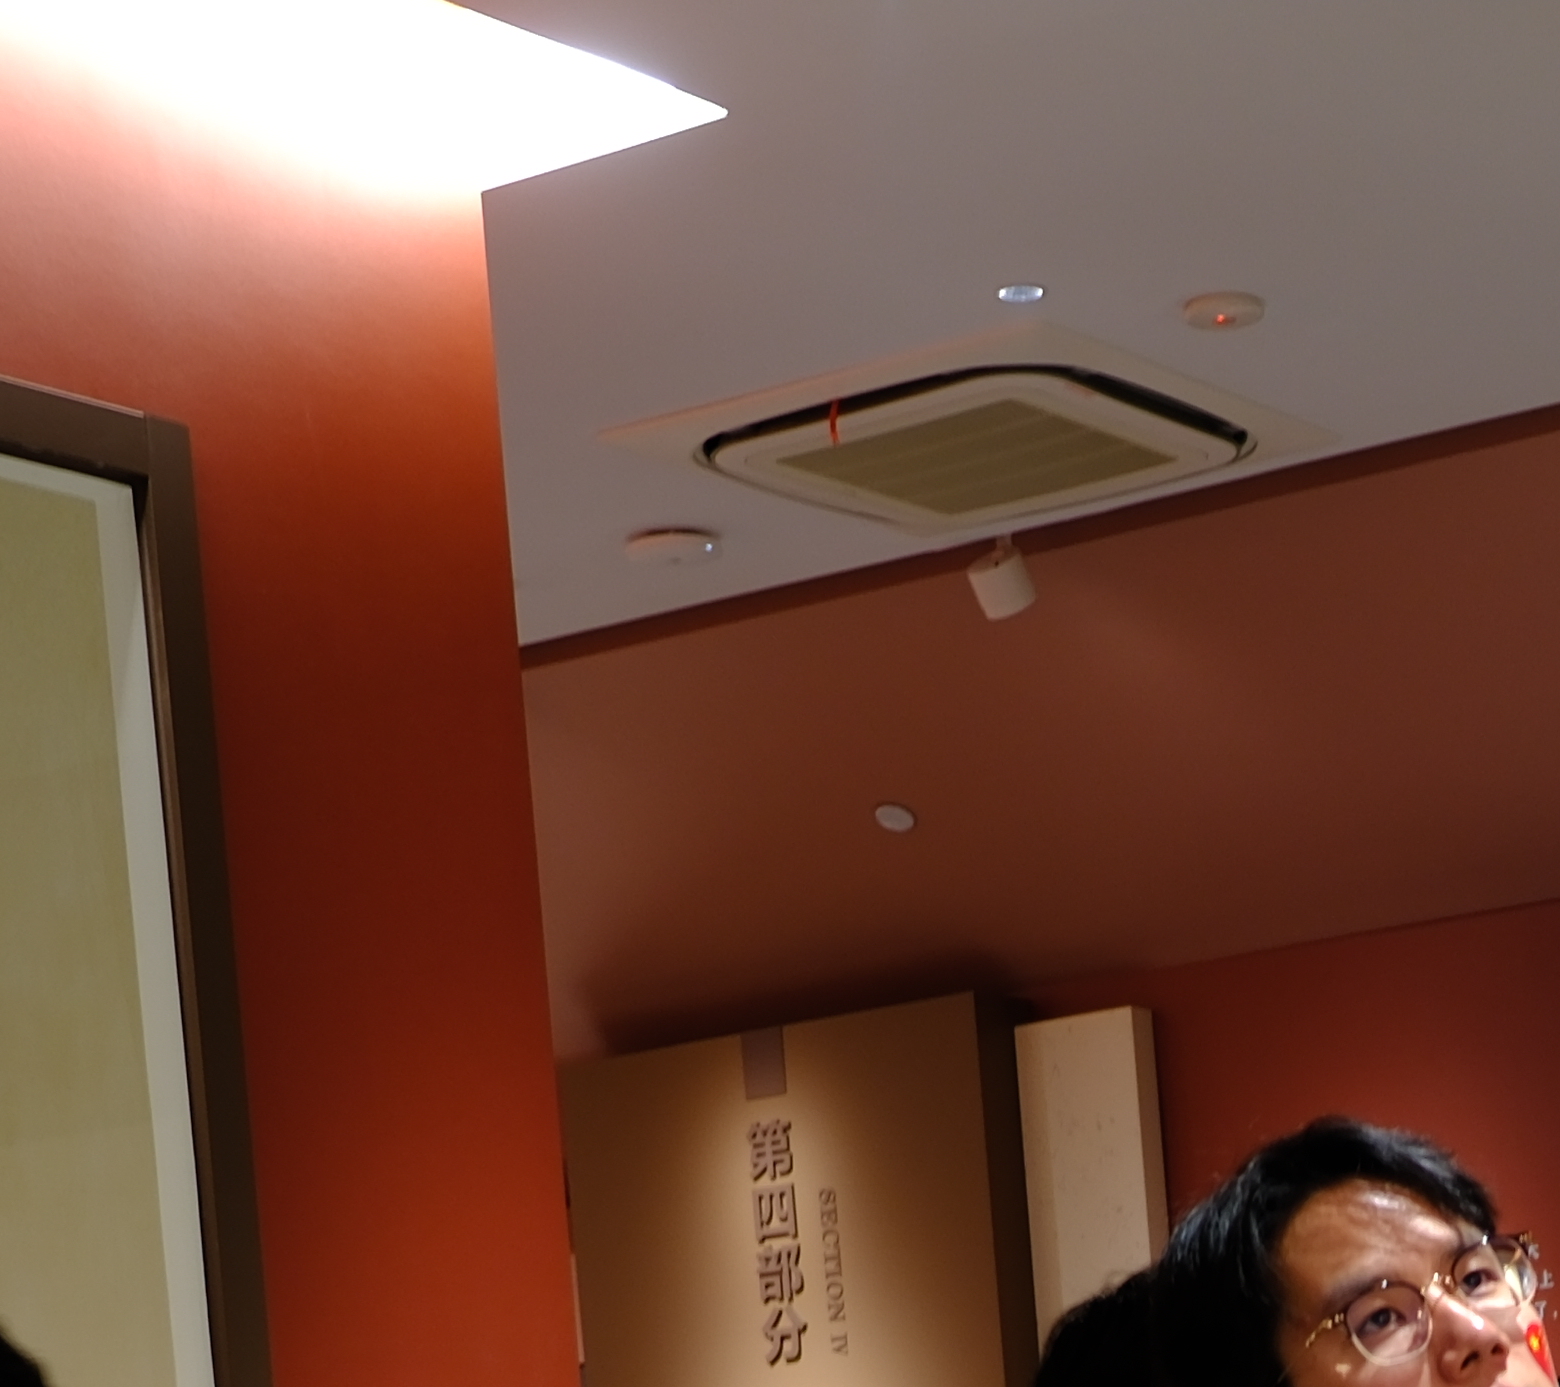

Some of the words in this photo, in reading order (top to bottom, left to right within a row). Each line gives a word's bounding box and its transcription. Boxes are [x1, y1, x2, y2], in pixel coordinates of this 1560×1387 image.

[746, 1117, 809, 1367] 第四部分
[818, 1187, 847, 1323] SECTION
[829, 1333, 850, 1356] IV
